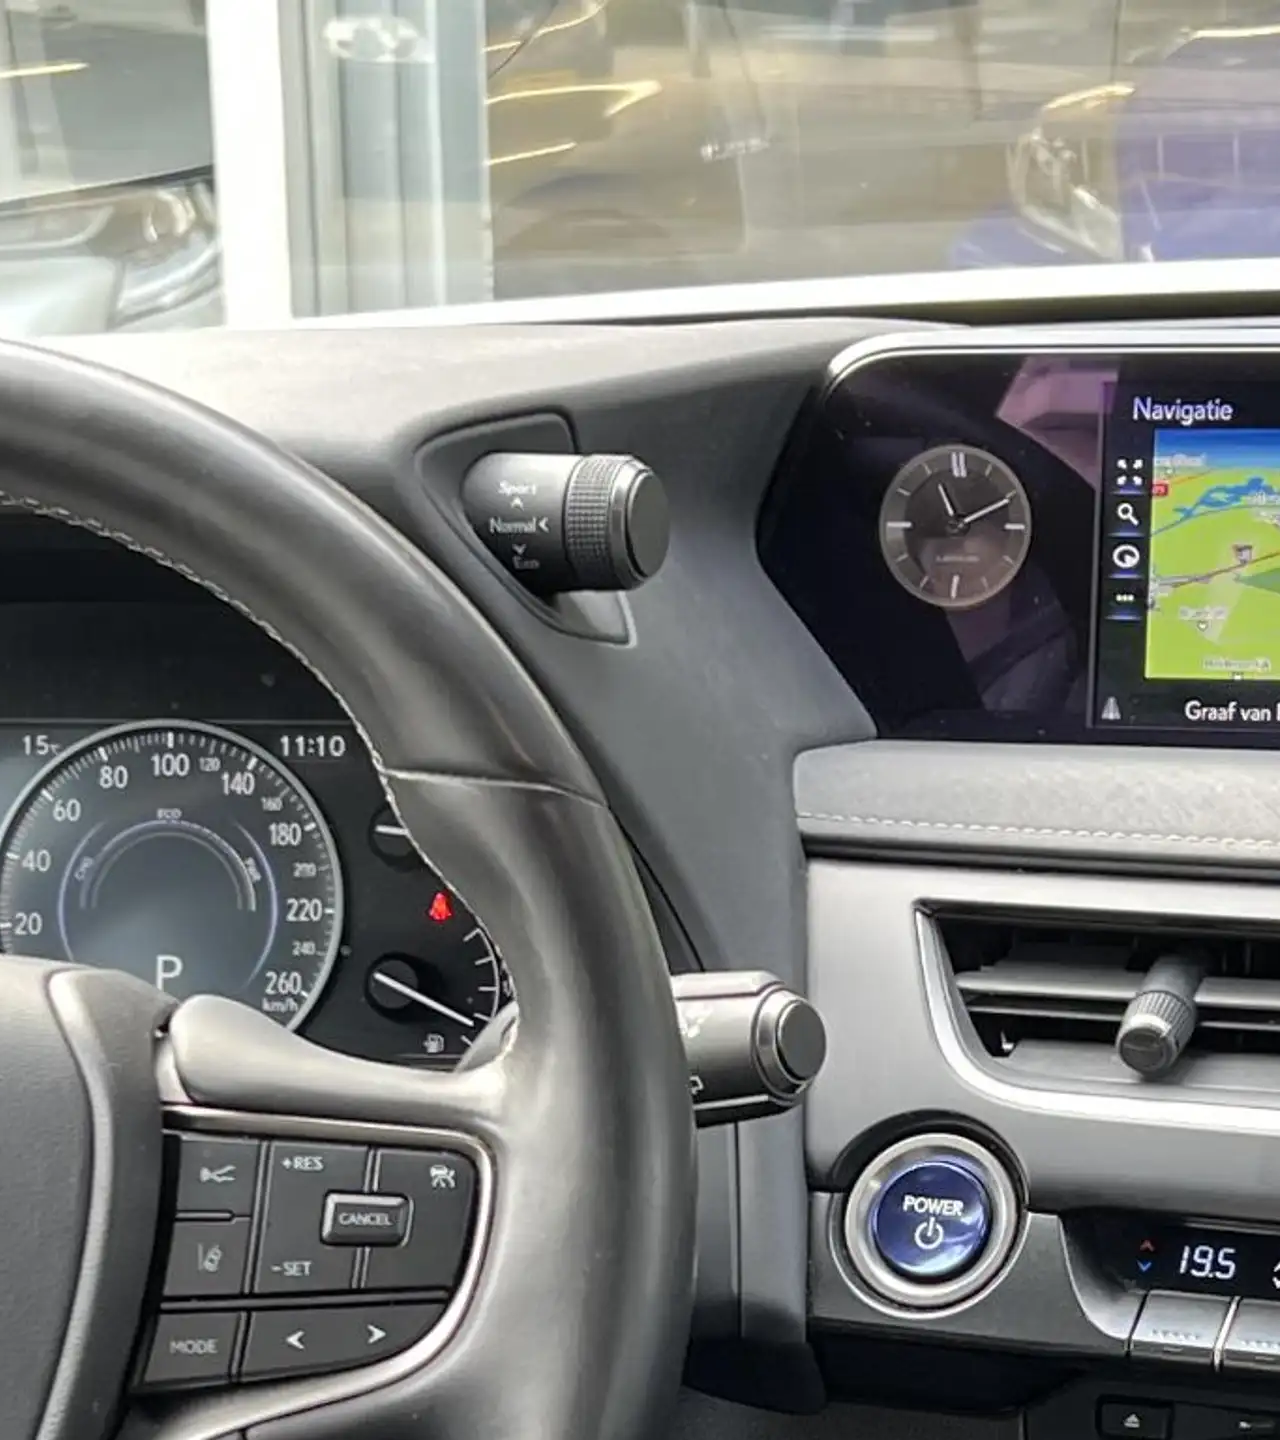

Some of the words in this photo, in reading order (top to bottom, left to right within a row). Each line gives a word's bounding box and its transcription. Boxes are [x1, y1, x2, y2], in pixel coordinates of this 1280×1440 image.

[1132, 396, 1233, 426] Navigatie
[497, 480, 537, 497] Sport
[489, 517, 536, 534] Normal
[1184, 700, 1237, 722] Graaf
[1240, 707, 1271, 722] van
[280, 735, 345, 757] 11:10
[151, 754, 190, 777] 100
[199, 757, 220, 772] 120
[99, 766, 128, 789] 80
[221, 773, 255, 796] 140
[53, 799, 81, 822] 60
[261, 797, 283, 812] 160
[269, 822, 302, 847] 180
[22, 850, 51, 873] 40
[286, 899, 322, 922] 220
[14, 912, 43, 936] 20
[292, 942, 316, 957] 240
[155, 955, 183, 992] P
[265, 972, 302, 997] 260
[262, 998, 299, 1014] km/h
[902, 1194, 965, 1217] POWER
[338, 1211, 393, 1228] CANCEL
[169, 1338, 218, 1355] MODE
